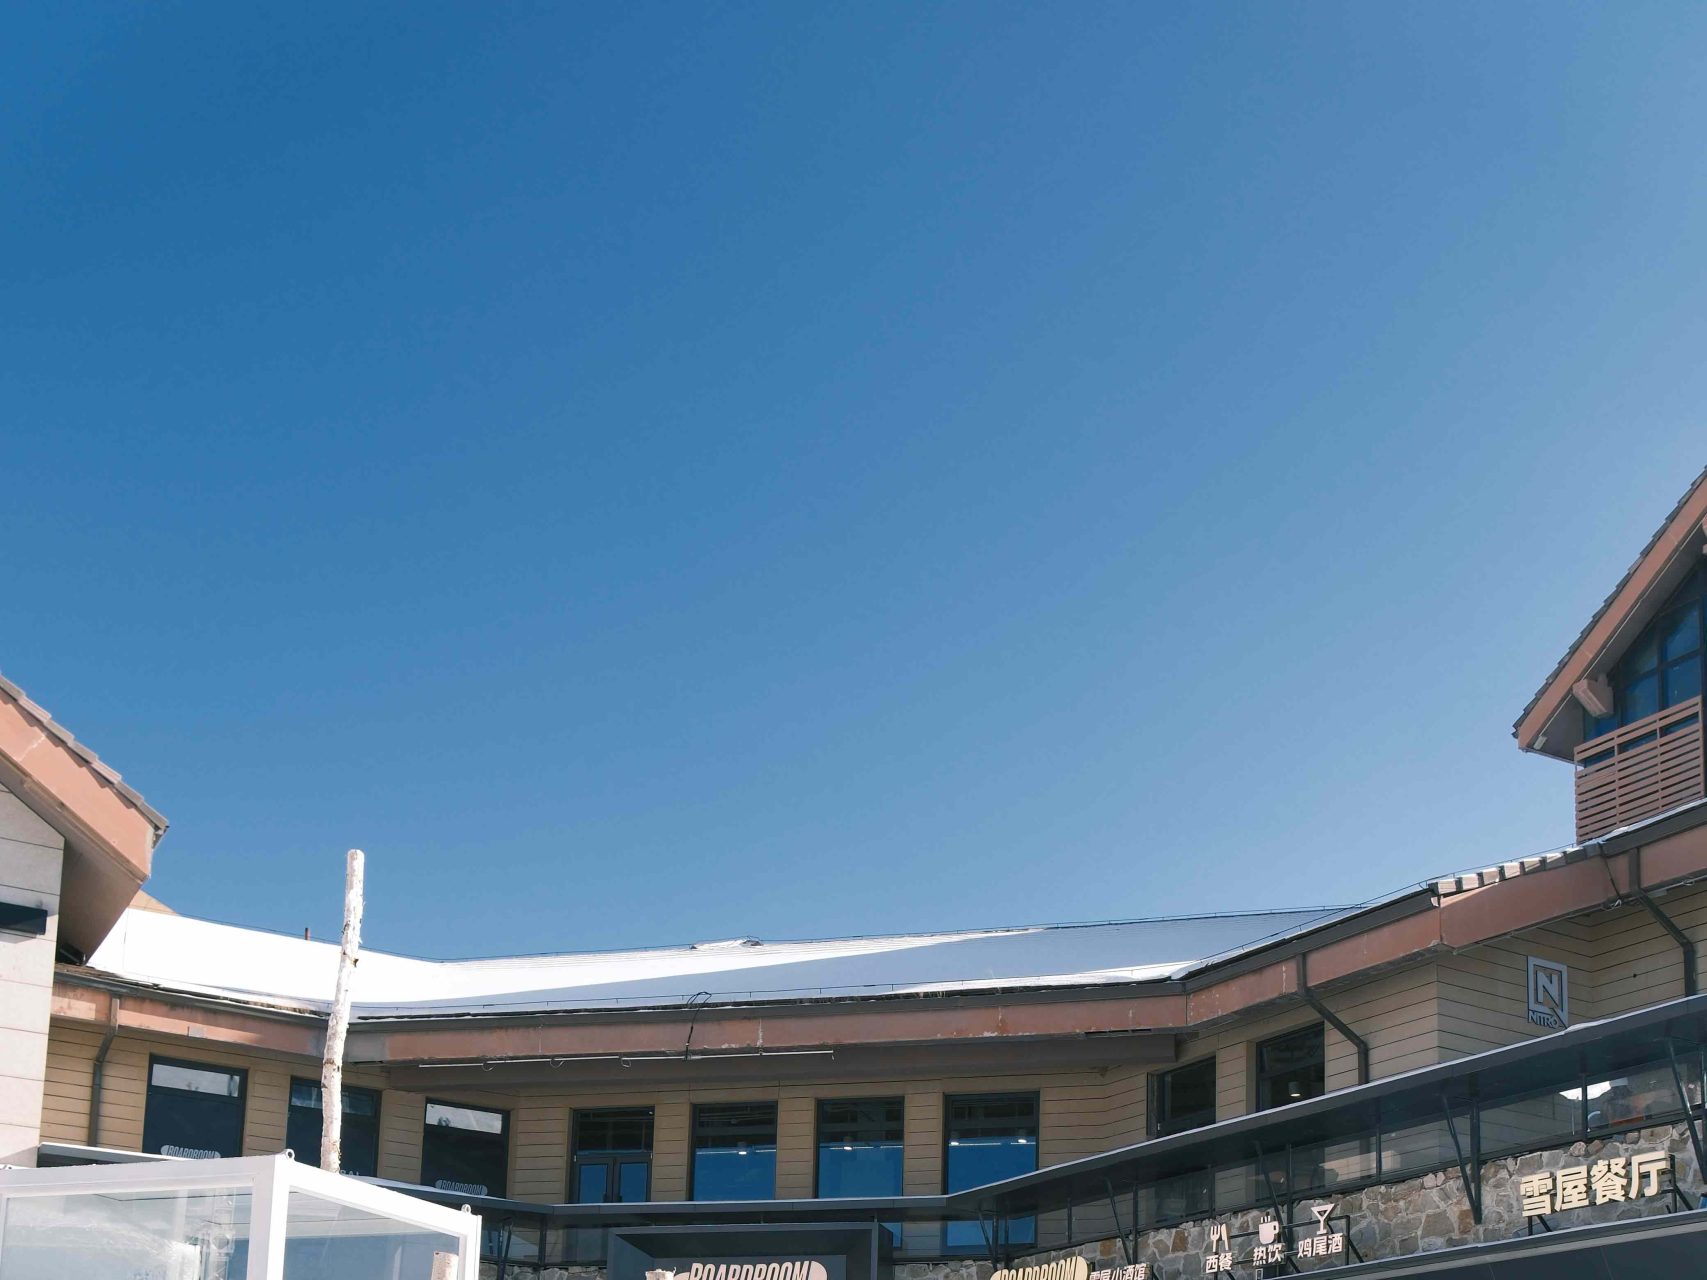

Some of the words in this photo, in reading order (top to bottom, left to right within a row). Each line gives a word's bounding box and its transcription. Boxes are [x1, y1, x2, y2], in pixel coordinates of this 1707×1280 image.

[1529, 1011, 1559, 1029] NITRO
[1519, 1150, 1669, 1217] 雪屋餐厅
[1205, 1252, 1233, 1274] 西餐
[1252, 1243, 1284, 1266] 热饮
[1297, 1233, 1344, 1258] 鸡尾酒
